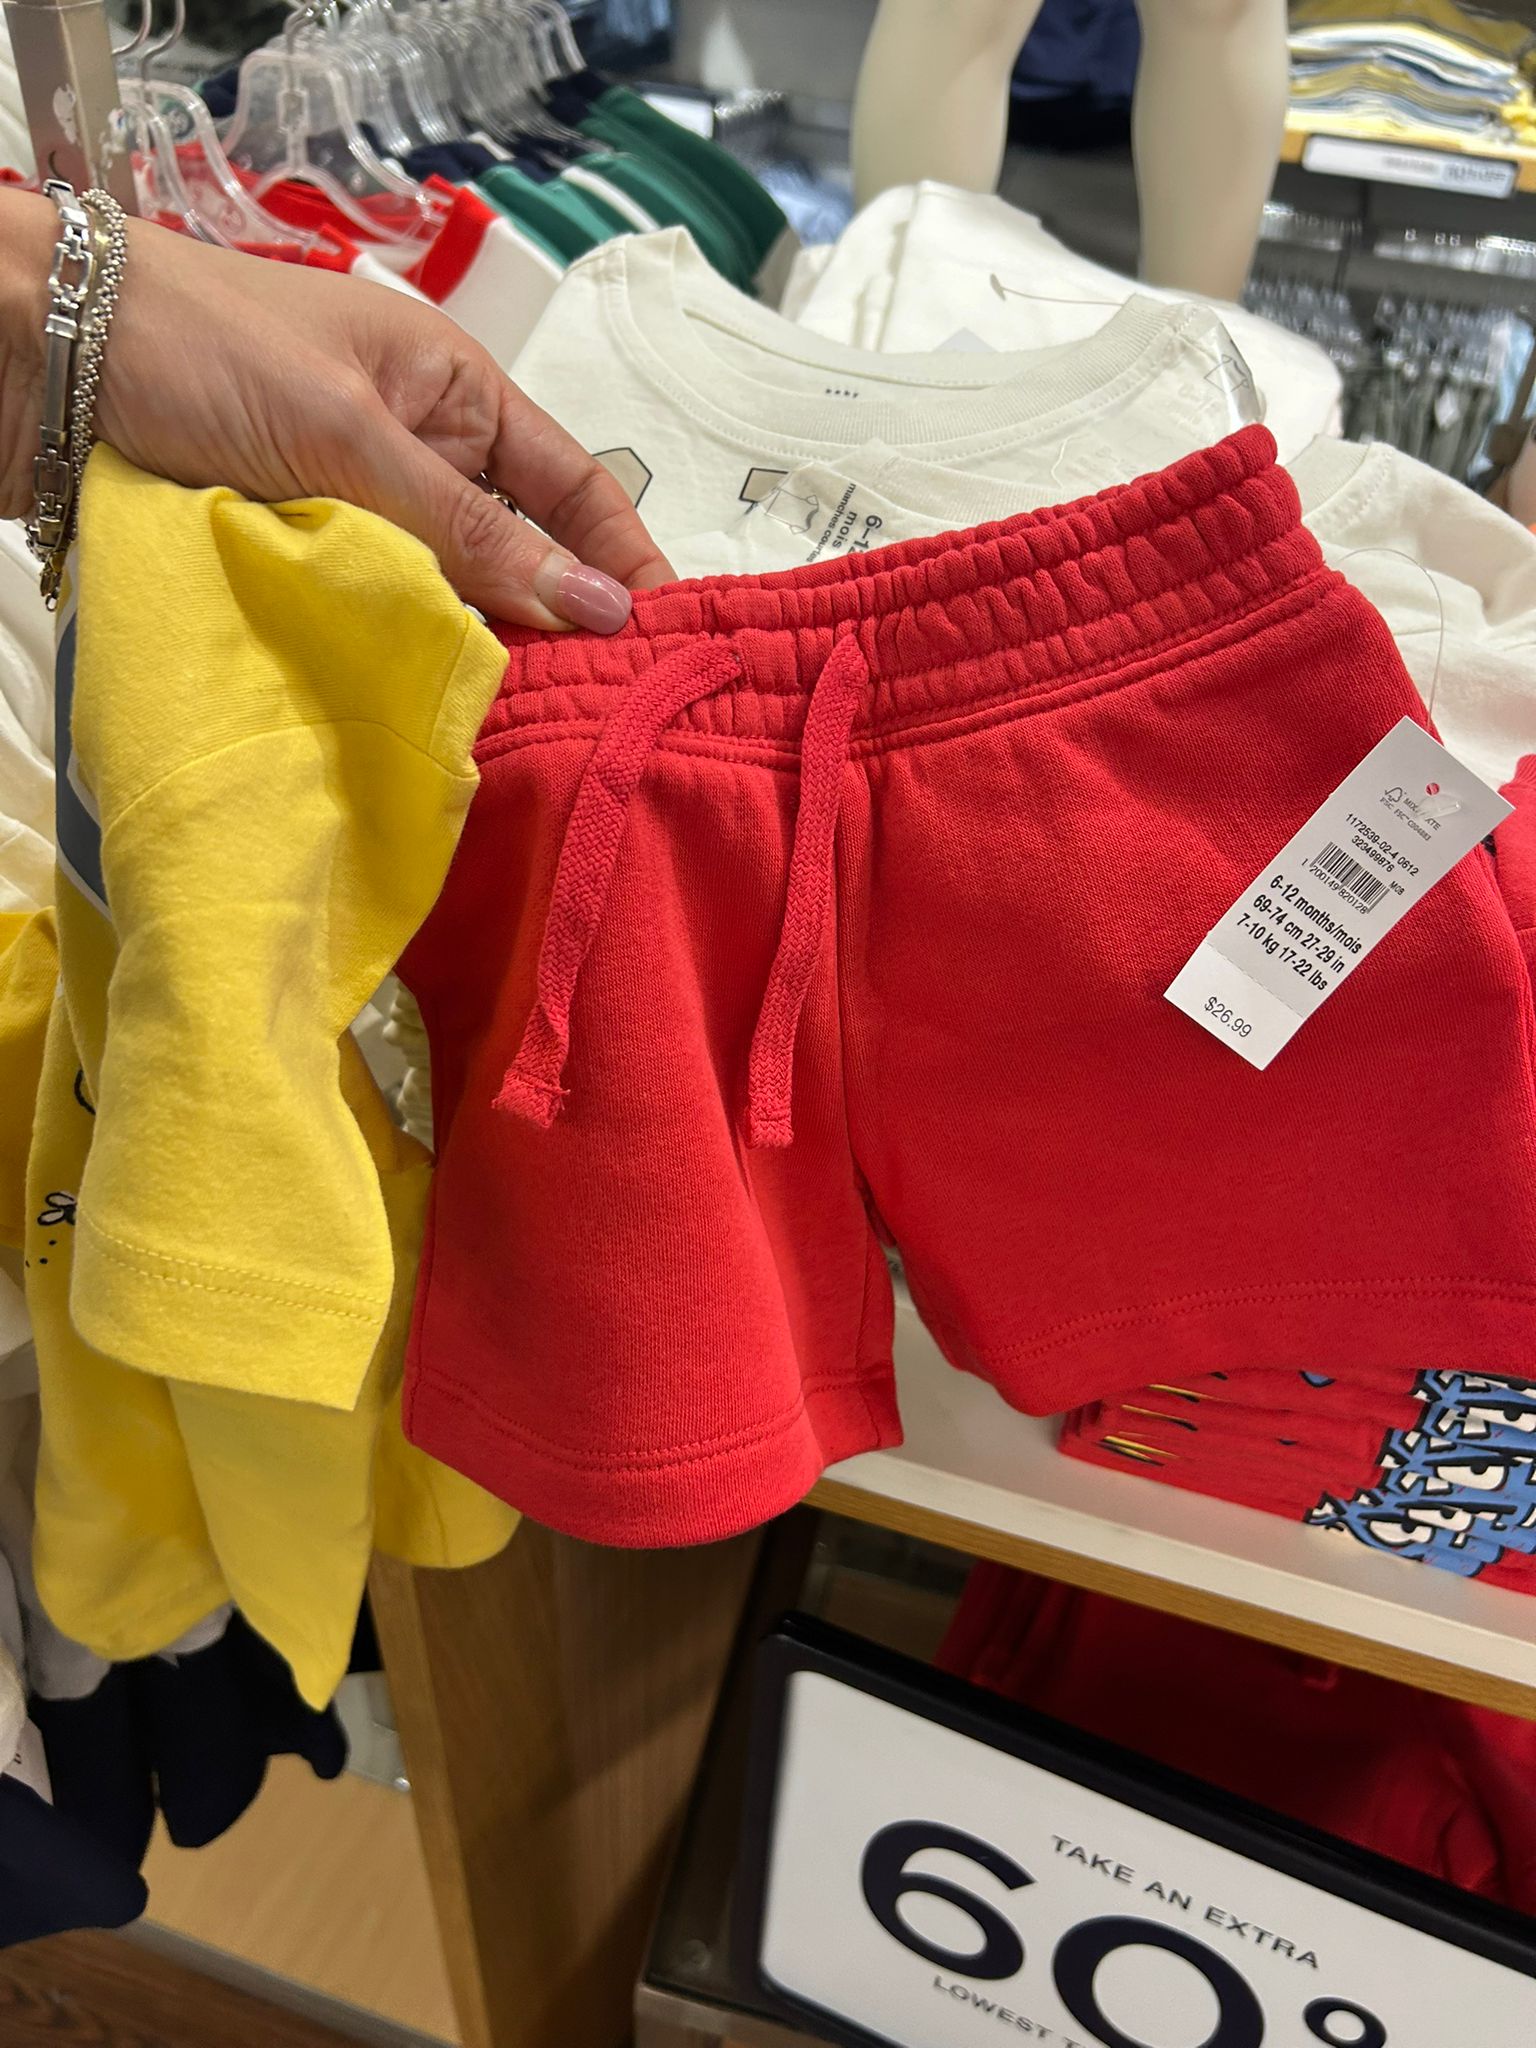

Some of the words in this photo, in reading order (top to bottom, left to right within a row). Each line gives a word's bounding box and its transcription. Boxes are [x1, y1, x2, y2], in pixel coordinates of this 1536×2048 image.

[828, 483, 856, 529] manches
[832, 511, 857, 548] mois
[1345, 813, 1399, 859] 1172539-02-4
[1397, 856, 1419, 876] 0612
[1351, 834, 1395, 873] 323499876
[1270, 874, 1299, 902] 6-12
[1293, 896, 1362, 954] months/mois
[1338, 888, 1369, 915] 820128
[1237, 912, 1266, 939] 7-10
[1261, 933, 1280, 954] kg
[1278, 946, 1312, 977] 17-22
[1307, 969, 1328, 990] lbs
[1253, 894, 1288, 925] 69-74
[1284, 921, 1303, 940] cm
[1300, 933, 1336, 963] 27-29
[1330, 955, 1345, 973] in
[1204, 996, 1252, 1037] $26.99
[1051, 1834, 1137, 1885] TAKE
[1143, 1879, 1193, 1911] AN
[1203, 1905, 1321, 1970] EXTRA
[932, 1974, 1054, 2039] LOWEST
